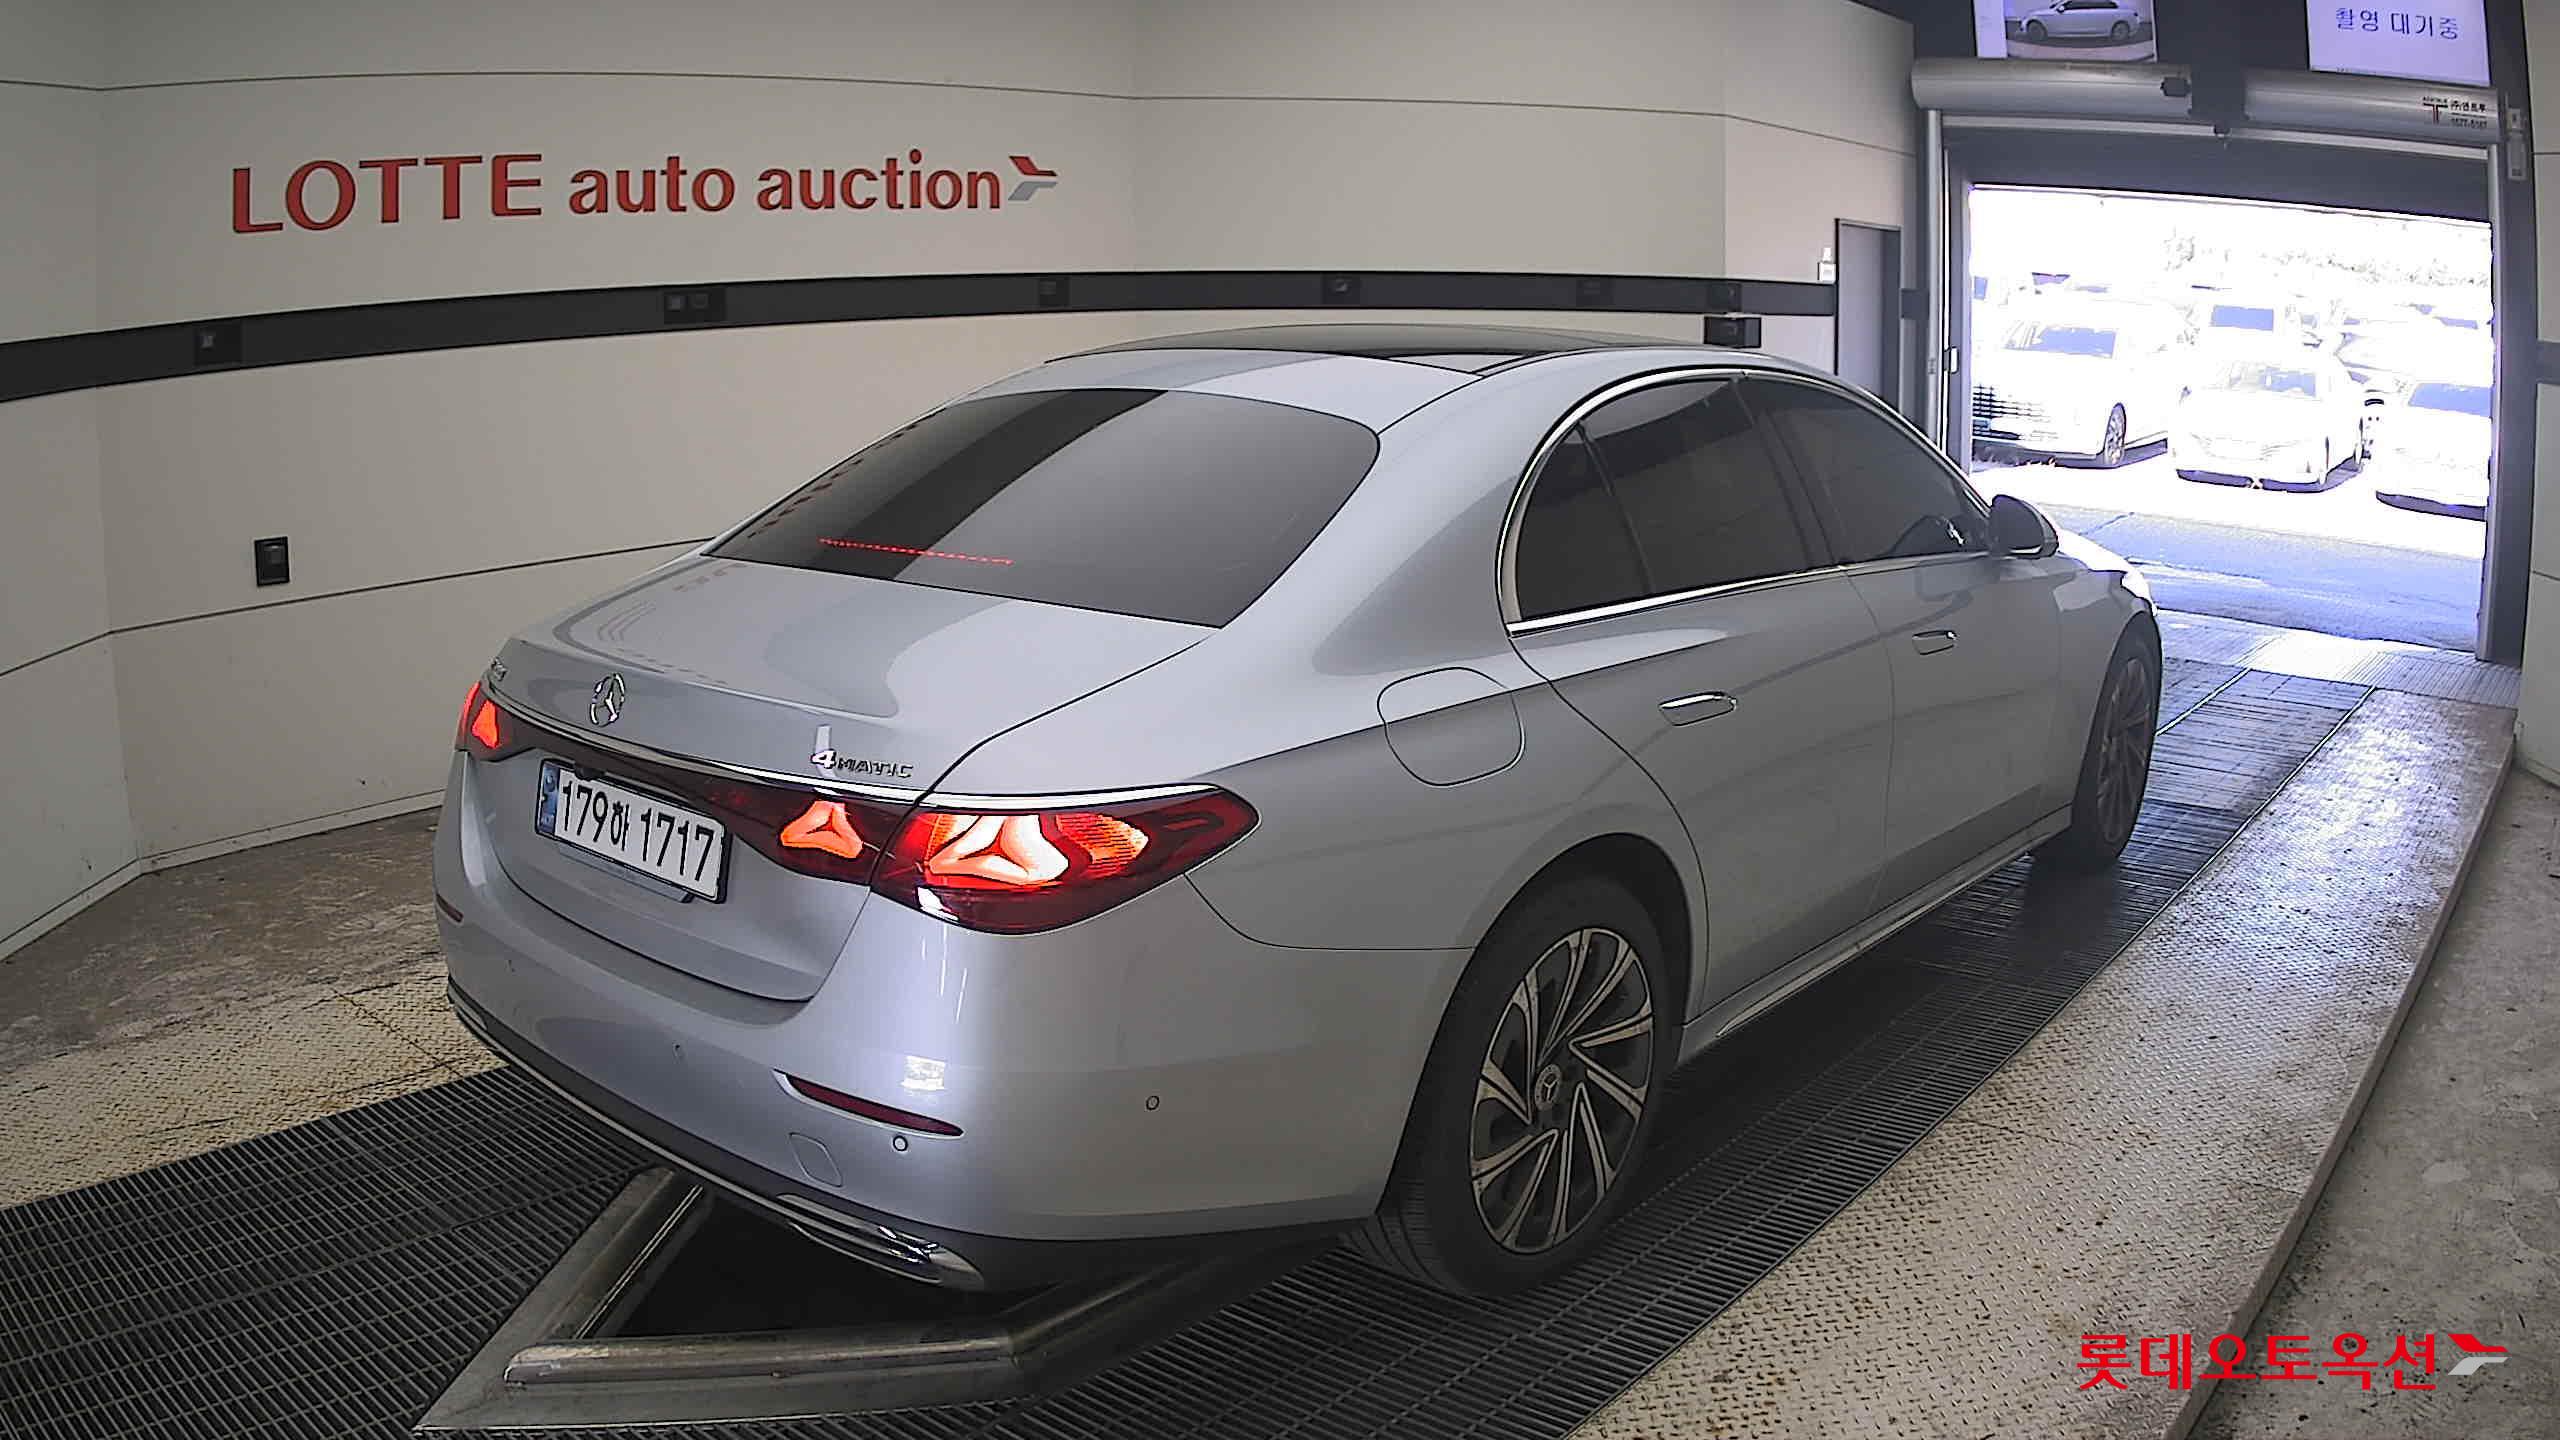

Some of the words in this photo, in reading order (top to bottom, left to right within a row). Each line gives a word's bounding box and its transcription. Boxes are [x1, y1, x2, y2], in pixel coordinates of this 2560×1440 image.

[2336, 8, 2380, 33] 촬영
[233, 153, 542, 233] LOTTE
[569, 155, 736, 214] auto
[757, 149, 1001, 211] auction
[811, 750, 914, 779] 4MATIC
[563, 781, 629, 852] 179하
[641, 808, 714, 881] 1717
